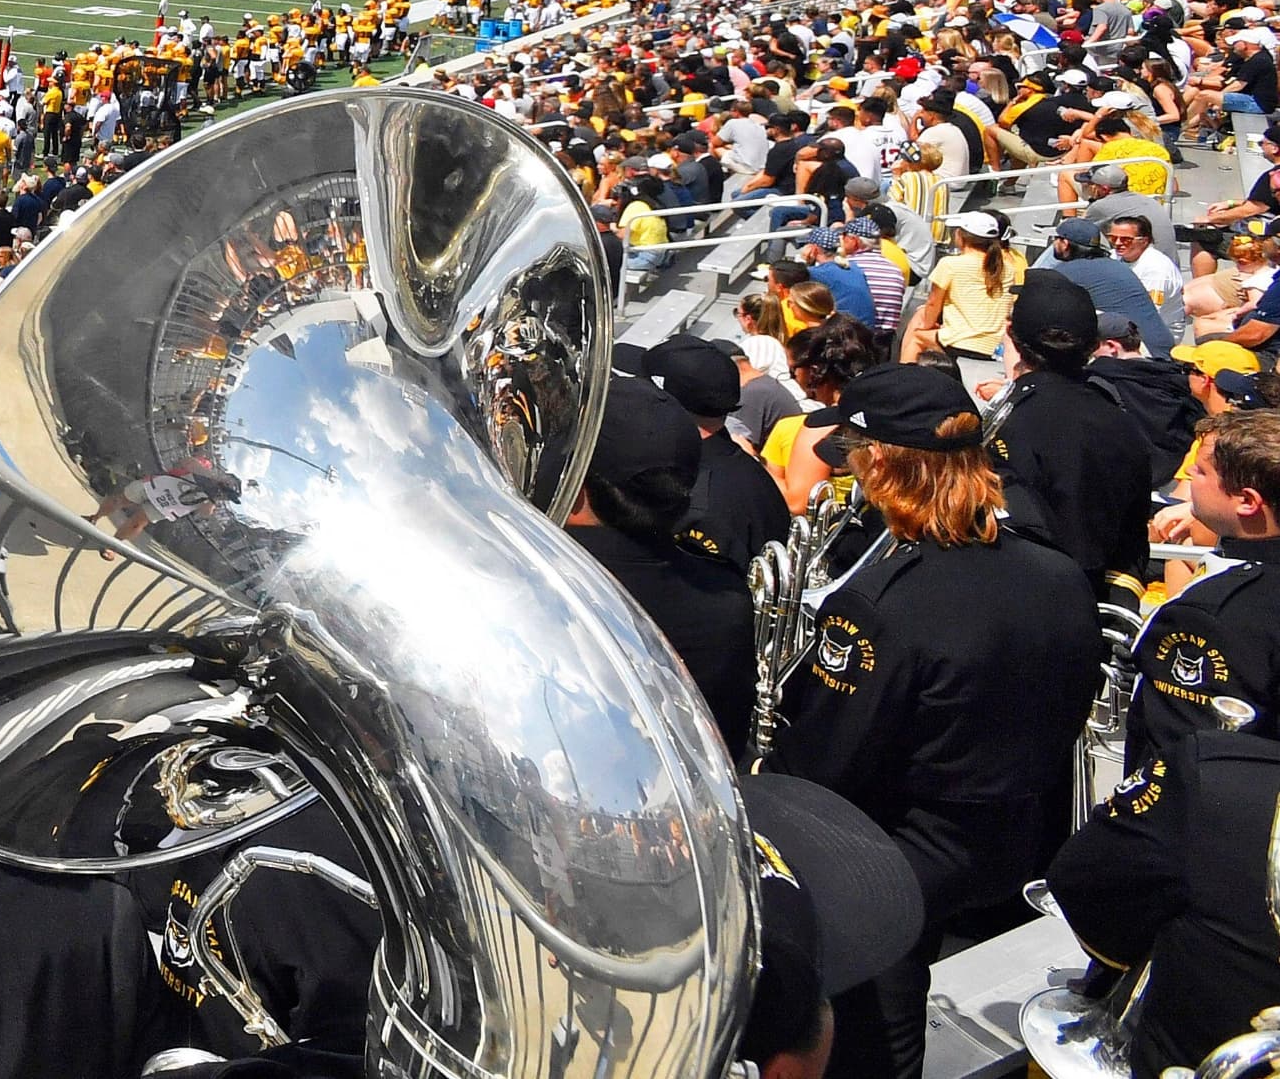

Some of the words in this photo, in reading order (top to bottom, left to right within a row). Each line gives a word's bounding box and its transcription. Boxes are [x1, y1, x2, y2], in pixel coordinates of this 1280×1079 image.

[994, 439, 1010, 461] STAT
[857, 638, 875, 673] STATE
[1155, 632, 1207, 661] KENNESAW
[1207, 648, 1230, 682] STATE
[1131, 782, 1162, 815] STATE
[204, 918, 223, 961] STAT
